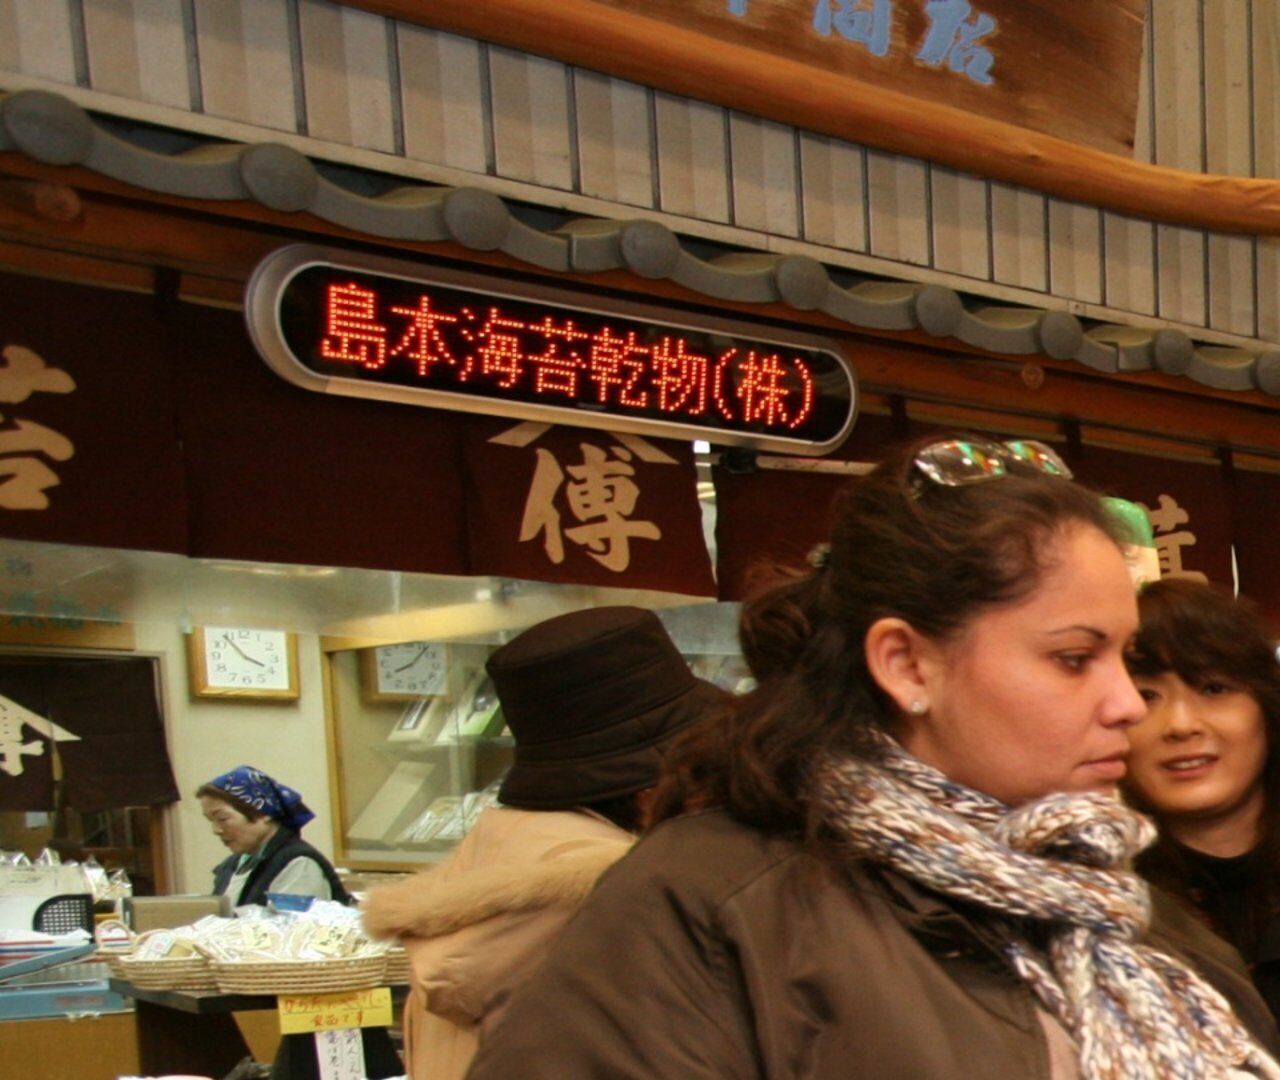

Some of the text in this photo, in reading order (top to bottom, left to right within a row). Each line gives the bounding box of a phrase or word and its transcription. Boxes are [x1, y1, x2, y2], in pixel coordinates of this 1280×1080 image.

[320, 282, 813, 429] 島本海苔乾物(株)
